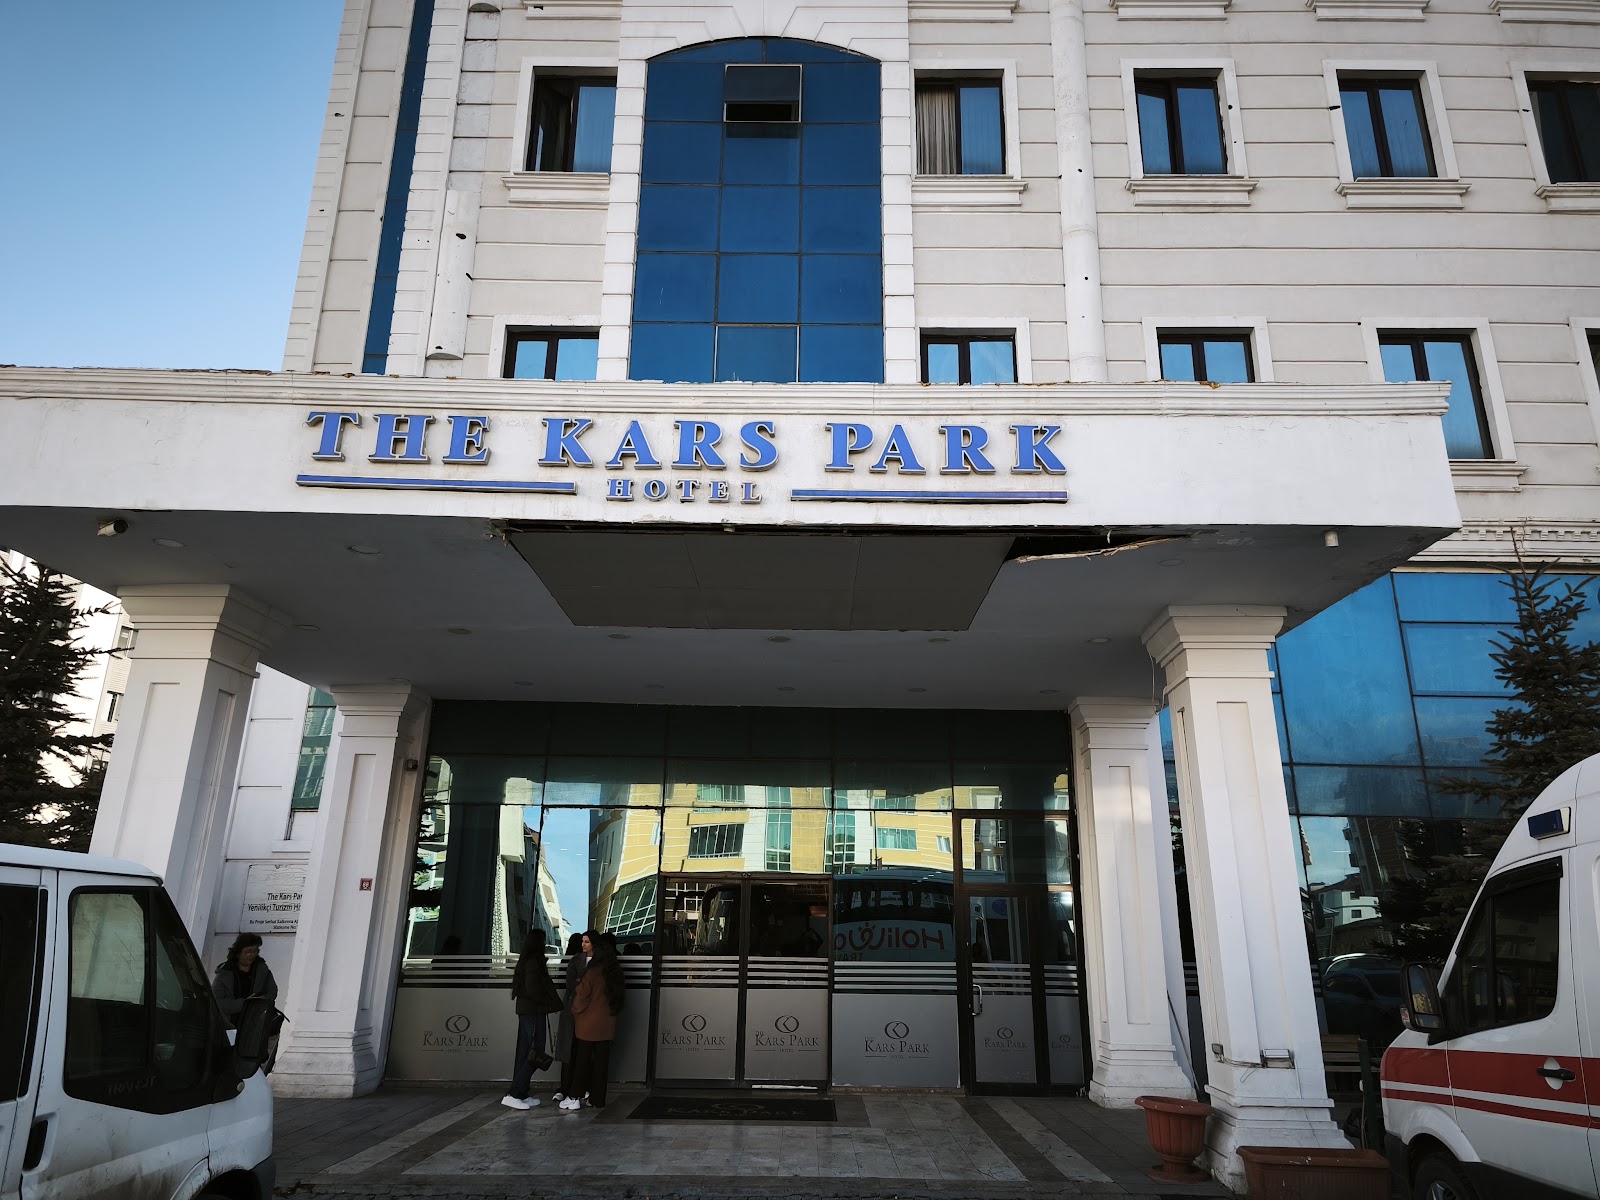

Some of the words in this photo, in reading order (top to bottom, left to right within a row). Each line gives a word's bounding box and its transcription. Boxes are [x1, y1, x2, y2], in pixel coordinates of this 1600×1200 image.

[305, 411, 491, 466] THE
[537, 417, 779, 472] KARS
[824, 422, 1067, 476] PARK
[606, 478, 762, 505] HOTEL
[267, 892, 279, 901] The
[279, 892, 292, 901] Kars
[272, 903, 293, 911] Turizm
[422, 1034, 454, 1047] KARS
[457, 1034, 488, 1047] PARK
[661, 1032, 692, 1046] KARS
[695, 1033, 726, 1046] PARK
[754, 1034, 785, 1047] KARS
[789, 1034, 820, 1047] PARK
[865, 1039, 895, 1053] KARS
[899, 1040, 930, 1053] PARK
